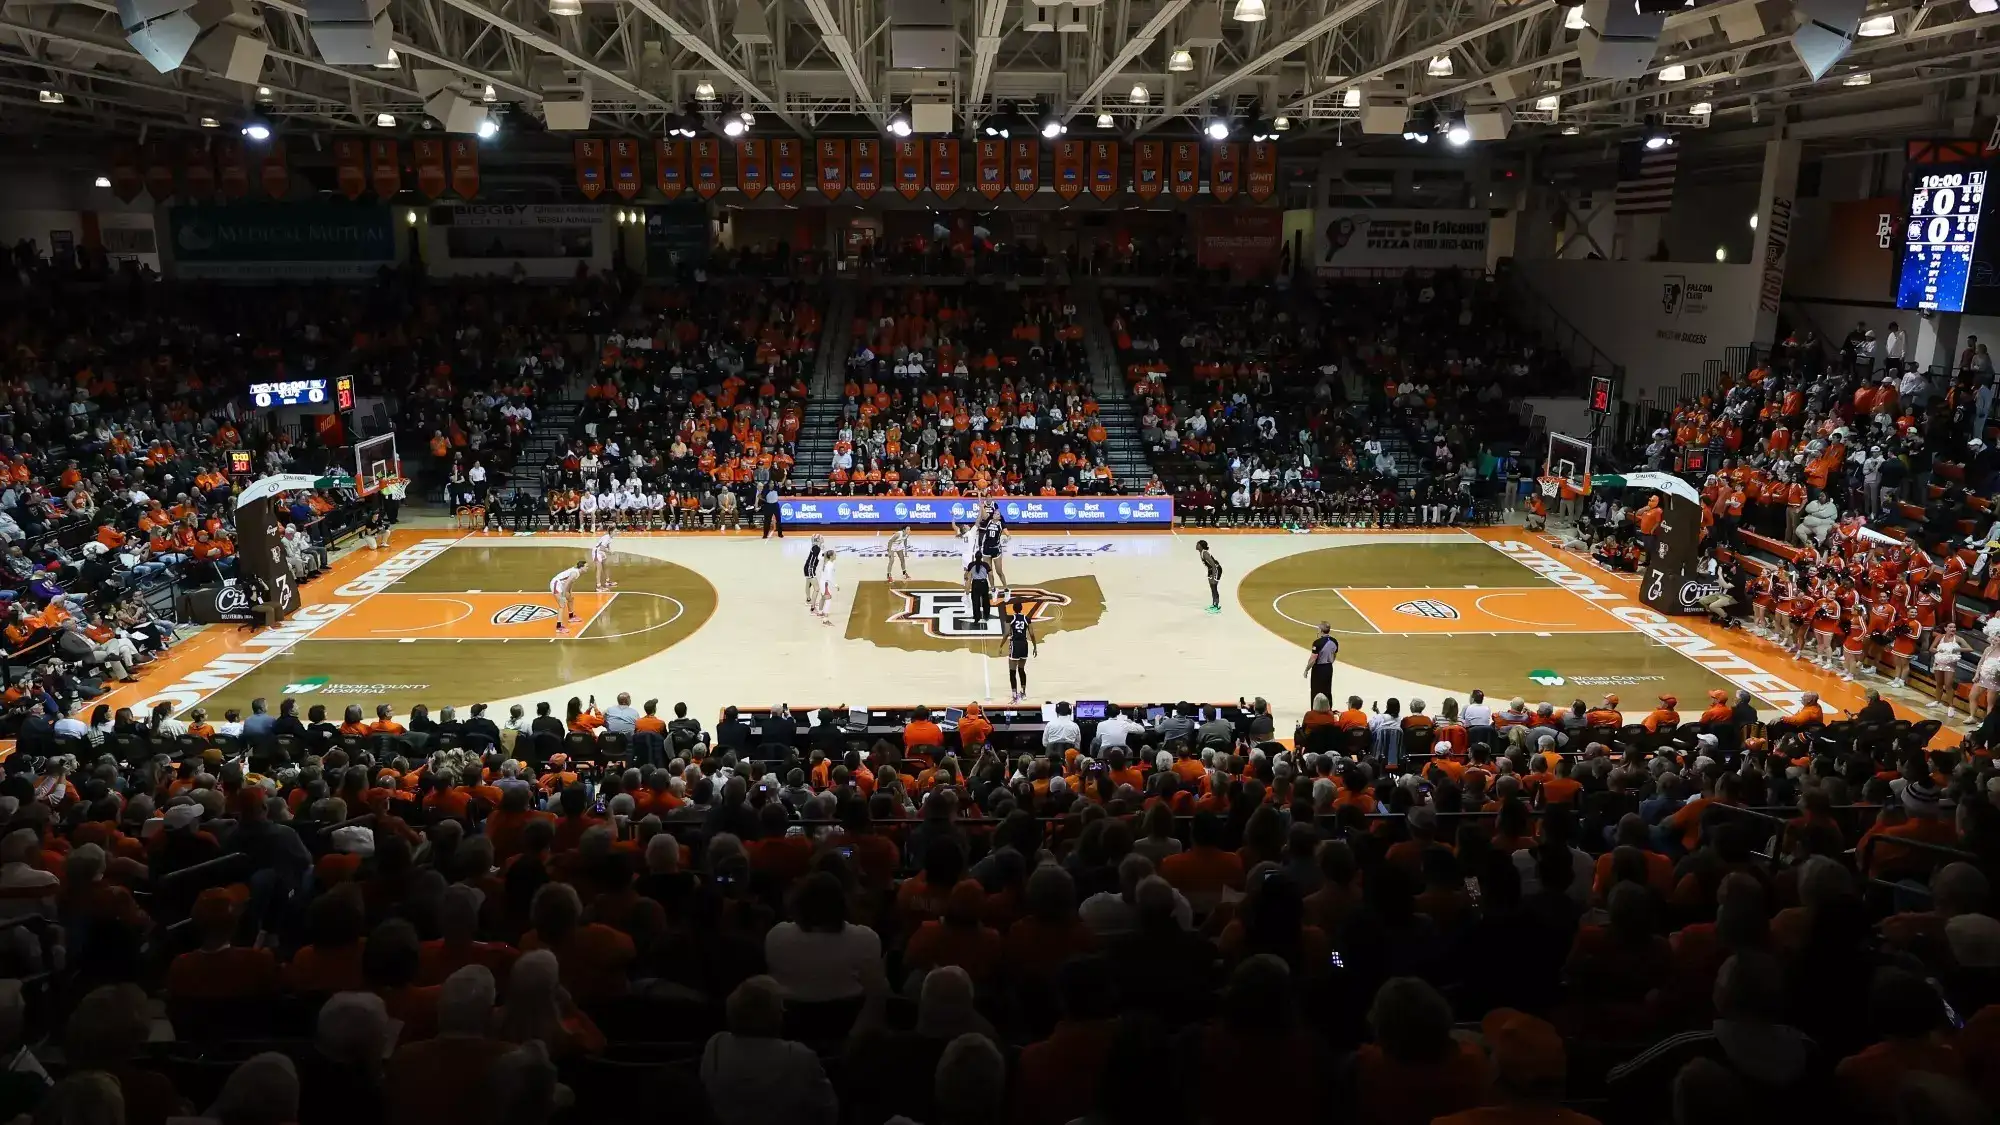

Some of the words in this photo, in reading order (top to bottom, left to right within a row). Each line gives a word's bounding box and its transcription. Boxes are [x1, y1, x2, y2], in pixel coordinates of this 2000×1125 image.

[1922, 174, 1962, 188] 10:00
[1973, 174, 1979, 183] 1
[1060, 184, 1078, 192] 2010
[1096, 184, 1112, 192] 2011
[1176, 184, 1192, 192] 2013
[1933, 189, 1955, 215] 0
[1962, 193, 1970, 202] 4
[1973, 193, 1980, 203] 0
[454, 205, 527, 215] BIGGBY
[1769, 197, 1792, 248] VILLE
[1414, 221, 1429, 234] Go
[1433, 221, 1487, 234] Falcons!
[1928, 217, 1949, 243] 0
[1957, 223, 1965, 232] 4
[1967, 223, 1975, 232] 0
[218, 225, 301, 241] MEDICAL
[309, 225, 384, 241] MUTUAL
[1368, 240, 1409, 248] PIZZA
[1687, 284, 1712, 293] FALCON
[1681, 333, 1707, 344] SUCCESS
[255, 393, 271, 407] 0
[309, 389, 324, 402] 0
[339, 390, 351, 408] 30
[234, 461, 246, 470] 30
[781, 506, 793, 516] BW
[802, 503, 816, 511] Best
[838, 506, 851, 516] BW
[858, 503, 873, 511] Best
[895, 506, 908, 516] BW
[916, 503, 930, 511] Best
[952, 506, 965, 516] BW
[972, 503, 980, 511] Be
[1007, 505, 1019, 515] BW
[1028, 503, 1042, 511] Best
[1064, 505, 1076, 515] BW
[1084, 503, 1099, 511] Best
[1118, 505, 1130, 515] BW
[1139, 503, 1153, 511] Best
[796, 510, 822, 519] Western
[852, 510, 879, 519] Western
[909, 510, 936, 519] Western
[1022, 509, 1048, 518] Western
[1078, 509, 1105, 518] Western
[1133, 509, 1159, 518] Western
[1861, 535, 1886, 544] BGSU
[333, 538, 461, 596] GREEN
[218, 587, 248, 610] Cit
[1015, 621, 1024, 629] 23
[1489, 540, 1628, 600] STROH
[1610, 606, 1839, 715] CENTER
[131, 603, 351, 720] OWLING
